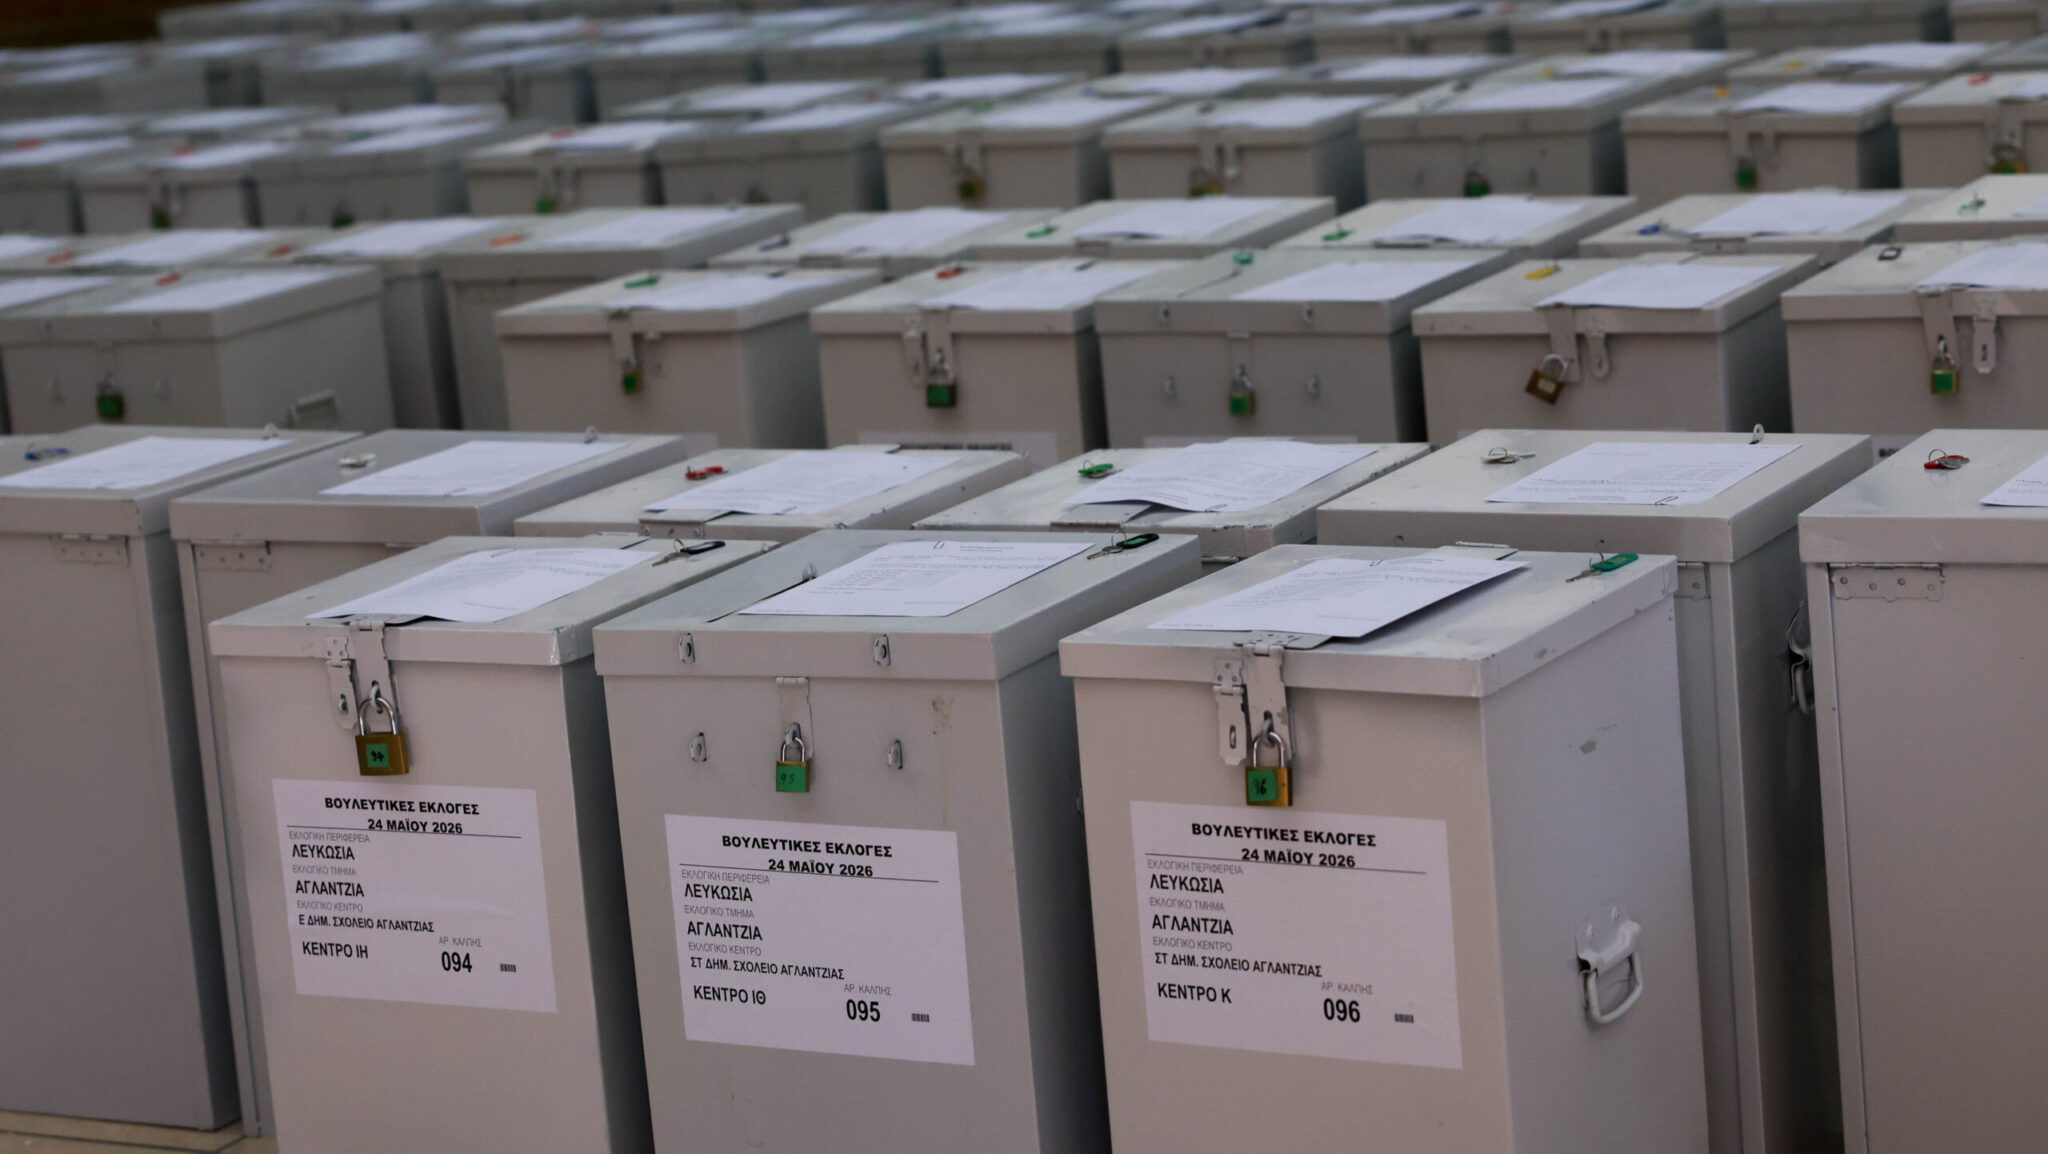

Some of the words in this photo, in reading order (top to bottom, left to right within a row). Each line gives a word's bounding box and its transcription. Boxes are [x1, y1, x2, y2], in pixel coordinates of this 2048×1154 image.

[325, 797, 416, 812] ΒΟΥΛΕΥΤΙΚΕΣ
[420, 802, 480, 815] ΕΚΛΟΓΕΣ
[368, 819, 382, 830] 24
[387, 818, 428, 832] ΜΑΪΟΥ
[432, 822, 463, 834] 2026
[289, 831, 324, 841] ΕΚΛΟΓΙΚΗ
[326, 833, 370, 842] ΠΕΡΙΦΕΡΕΙΑ
[1192, 823, 1299, 842] ΒΟΥΛΕΥΤΙΚΕΣ
[1304, 831, 1376, 847] ΕΚΛΟΓΕΣ
[292, 844, 355, 860] ΛΕΥΚΩΣΙΑ
[722, 836, 821, 853] ΒΟΥΛΕΥΤΙΚΕΣ
[826, 842, 892, 857] ΕΚΛΟΓΕΣ
[1242, 848, 1259, 861] 24
[1264, 849, 1313, 865] ΜΑΪΟΥ
[1319, 854, 1355, 868] 2026
[293, 865, 328, 875] ΕΚΛΟΓΙΚΟ
[331, 866, 356, 876] ΤΜΗΜΑ
[768, 859, 784, 871] 24
[789, 860, 834, 874] ΜΑΪΟΥ
[839, 864, 873, 877] 2026
[1147, 859, 1189, 871] ΕΚΛΟΓΙΚΗ
[1191, 861, 1243, 875] ΠΕΡΙΦΕΡΕΙΑ
[682, 869, 720, 880] ΕΚΛΟΓΙΚΗ
[722, 872, 770, 884] ΠΕΡΙΦΕΡΕΙΑ
[1150, 874, 1224, 894] ΛΕΥΚΩΣΙΑ
[296, 880, 364, 896] ΑΓΛΑΝΤΖΙΑ
[684, 883, 753, 901] ΛΕΥΚΩΣΙΑ
[297, 900, 332, 911] ΕΚΛΟΓΙΚΟ
[334, 902, 363, 912] ΚΕΝΤΡΟ
[684, 905, 723, 916] ΕΚΛΟΓΙΚΟ
[726, 907, 754, 919] ΤΜΗΜΑ
[1150, 897, 1191, 909] ΕΚΛΟΓΙΚΟ
[1194, 900, 1225, 912] ΤΜΗΜΑ
[299, 915, 305, 925] Ε
[308, 916, 330, 927] ΔΗΜ.
[333, 917, 374, 929] ΣΧΟΛΕΙΟ
[376, 920, 435, 932] ΑΓΛΑΝΤΖΙΑΣ
[687, 921, 762, 940] ΑΓΛΑΝΤΖΙΑ
[1152, 914, 1233, 935] ΑΓΛΑΝΤΖΙΑ
[302, 942, 353, 958] ΚΕΝΤΡΟ
[356, 945, 368, 958] ΙΗ
[452, 937, 482, 948] ΚΑΛΠΗΣ
[688, 942, 727, 953] ΕΚΛΟΓΙΚΟ
[729, 945, 761, 956] ΚΕΝΤΡΟ
[1153, 936, 1195, 949] ΕΚΛΟΓΙΚΟ
[1197, 939, 1232, 951] ΚΕΝΤΡΟ
[441, 951, 472, 972] 094
[690, 957, 702, 968] ΣΤ
[706, 958, 731, 970] ΔΗΜ.
[734, 960, 777, 974] ΣΧΟΛΕΙΟ
[780, 964, 845, 980] ΑΓΛΑΝΤΖΙΑΣ
[1155, 952, 1168, 964] ΣΤ
[1171, 954, 1198, 967] ΔΗΜ.
[1201, 956, 1249, 971] ΣΧΟΛΕΙΟ
[1253, 961, 1322, 977] ΑΓΛΑΝΤΖΙΑΣ
[694, 985, 748, 1003] ΚΕΝΤΡΟ
[752, 990, 766, 1005] ΙΘ
[859, 985, 892, 996] ΚΑΛΠΗΣ
[1158, 983, 1216, 1001] ΚΕΝΤΡΟ
[1221, 988, 1232, 1003] Κ
[1338, 983, 1373, 994] ΚΑΛΠΗΣ
[846, 999, 881, 1022] 095
[1323, 998, 1360, 1022] 096
